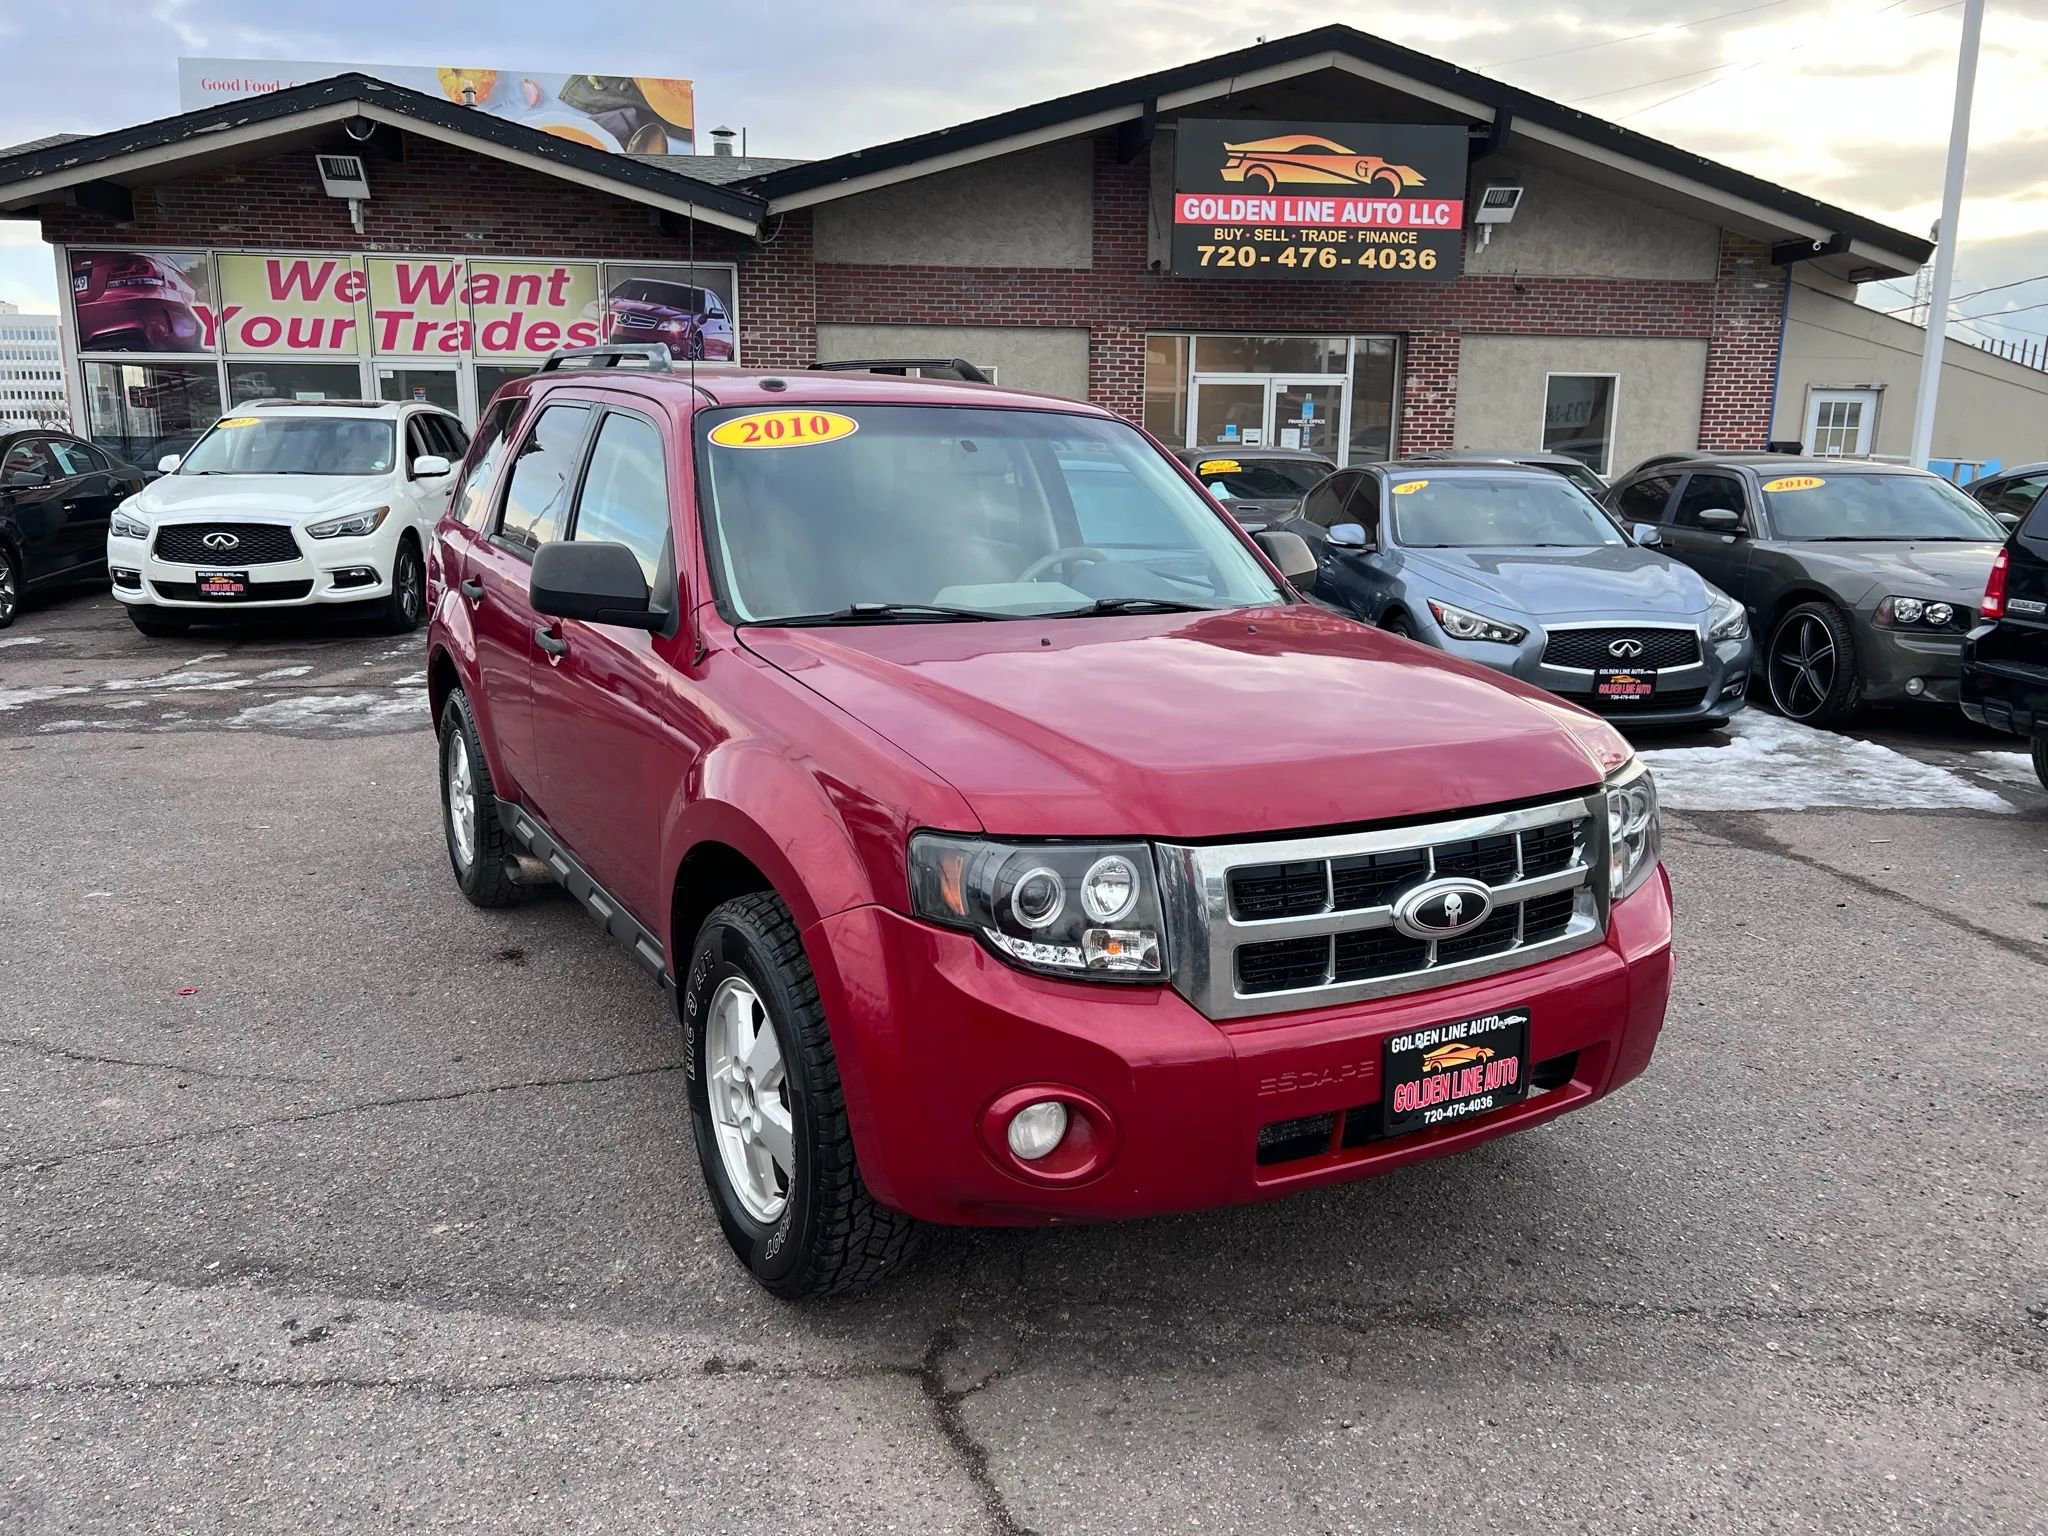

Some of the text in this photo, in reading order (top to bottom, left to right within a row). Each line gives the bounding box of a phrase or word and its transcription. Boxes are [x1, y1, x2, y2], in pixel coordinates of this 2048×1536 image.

[201, 78, 240, 91] Good
[1355, 160, 1369, 178] G
[1183, 198, 1450, 225] GOLDEN LINE AUTO LLC
[1214, 228, 1418, 244] BUY SELL TRADE FINANCE
[266, 259, 571, 307] We Want
[191, 305, 615, 353] Your Trades!
[740, 415, 830, 443] 2010
[1776, 479, 1813, 489] 2010
[1598, 683, 1652, 695] GOLDEN LINE AUTO
[1391, 1015, 1499, 1053] GOLDEN LINE AUTO
[1257, 1060, 1375, 1097] ESCAPE
[1393, 1056, 1518, 1113] GOLDEN LINE AUTO
[1424, 1096, 1493, 1124] 720-476-4036
